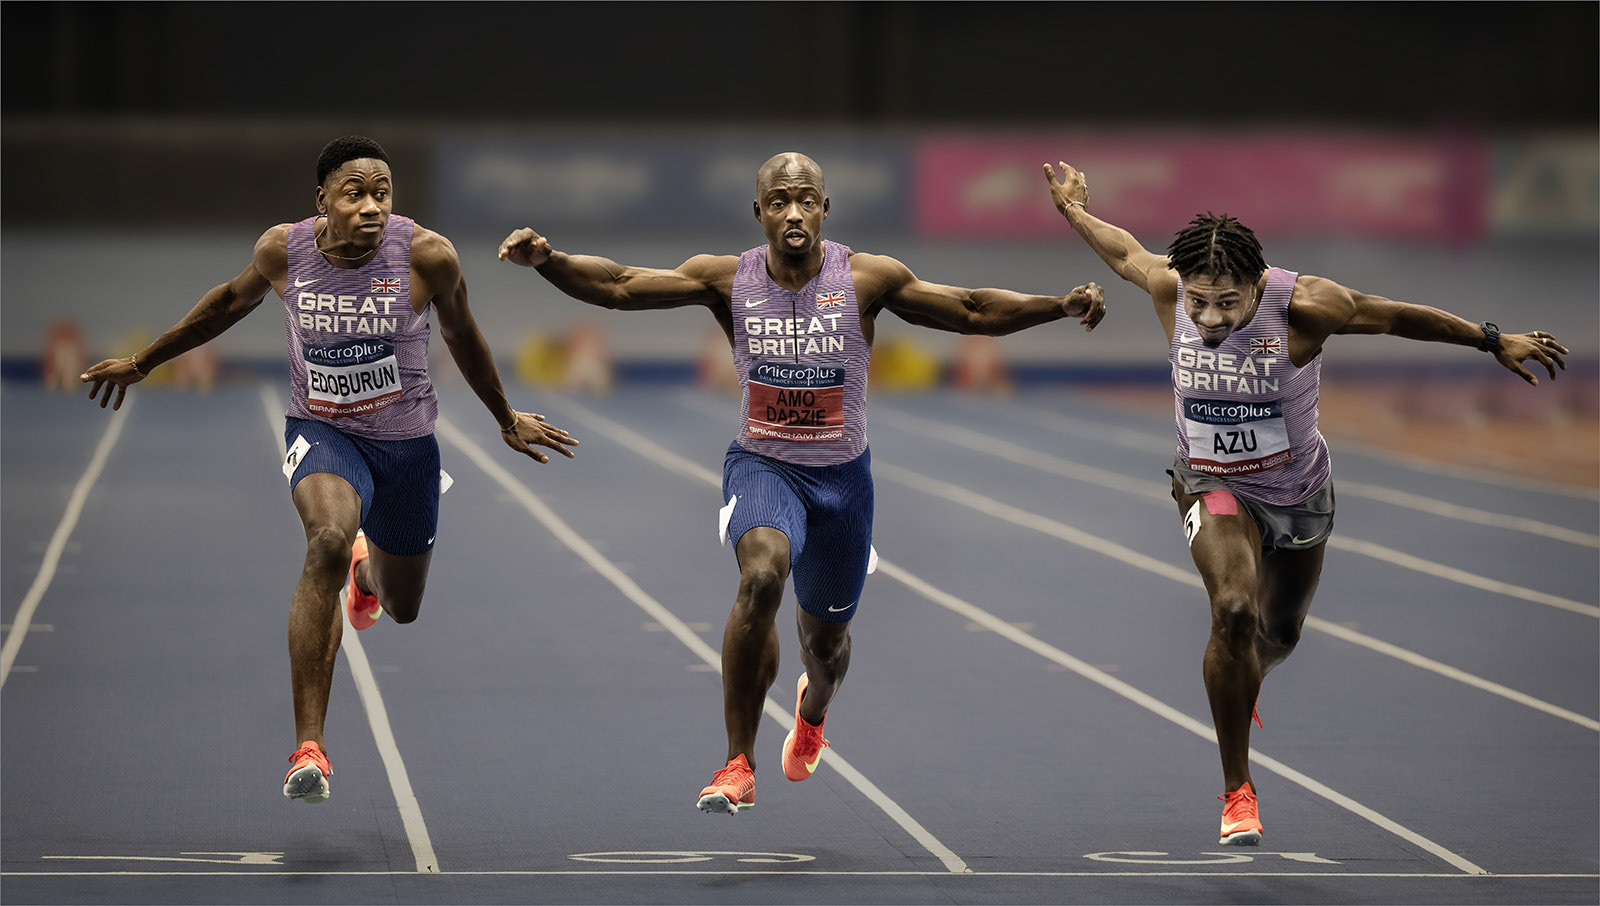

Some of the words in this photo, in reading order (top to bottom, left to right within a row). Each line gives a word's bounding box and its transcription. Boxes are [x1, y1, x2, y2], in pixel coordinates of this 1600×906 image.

[297, 292, 397, 315] GREAT
[299, 313, 397, 334] BRITAIN
[744, 313, 843, 336] GREAT
[748, 335, 844, 356] BRITAIN
[1178, 346, 1277, 377] GREAT
[309, 364, 396, 397] EDOBURUN
[1178, 369, 1279, 395] BRITAIN
[309, 403, 373, 414] BIRMINGHAM
[777, 390, 815, 408] AMO
[766, 405, 826, 426] DADZIE
[749, 426, 813, 439] BIRMINGHAM
[1213, 429, 1258, 455] AZU
[1191, 464, 1260, 474] BIRMINGHAM
